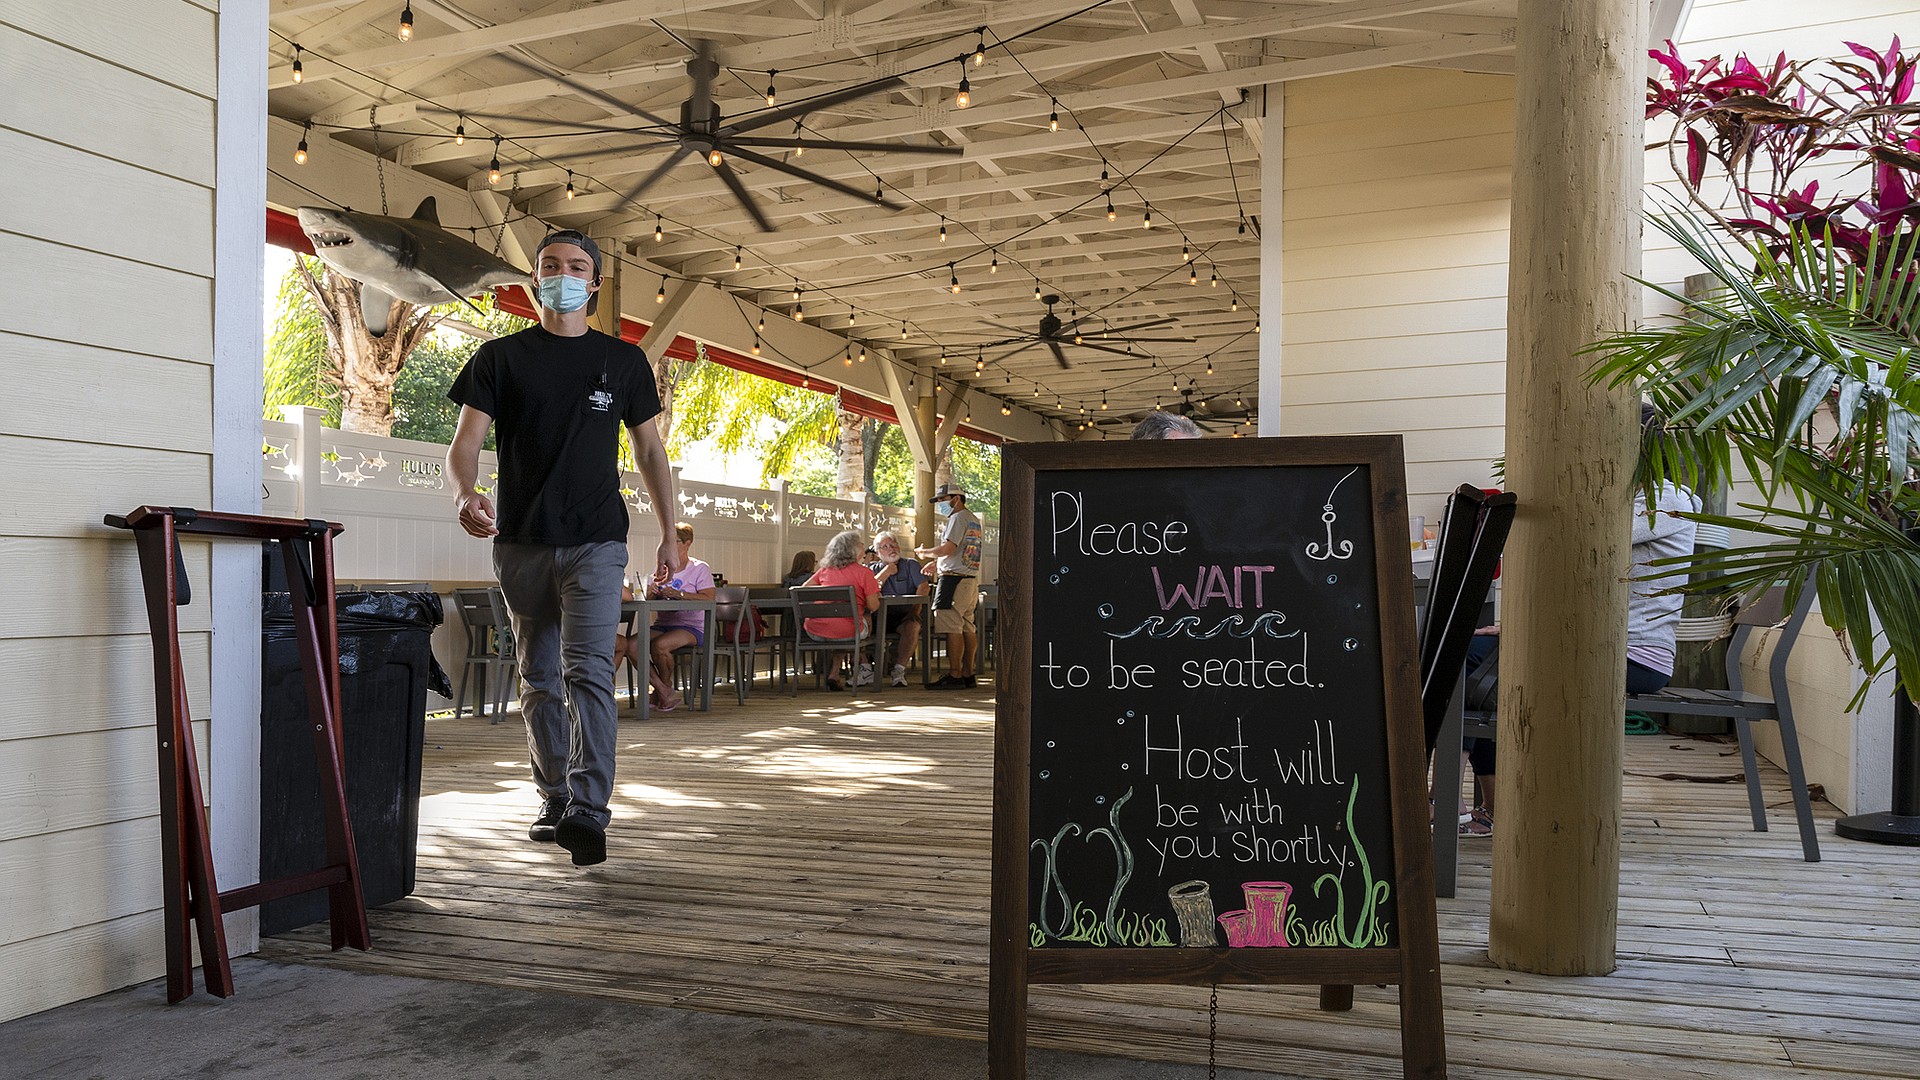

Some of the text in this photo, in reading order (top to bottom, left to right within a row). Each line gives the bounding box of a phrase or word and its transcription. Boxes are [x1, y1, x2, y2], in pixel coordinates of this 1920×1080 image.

[401, 459, 442, 477] HULL'S
[1051, 490, 1188, 557] Please
[1151, 564, 1275, 611] WAIT
[1039, 632, 1325, 690] to be seated.
[1144, 714, 1345, 785] Host will
[1155, 784, 1283, 828] be with
[1146, 835, 1221, 877] you
